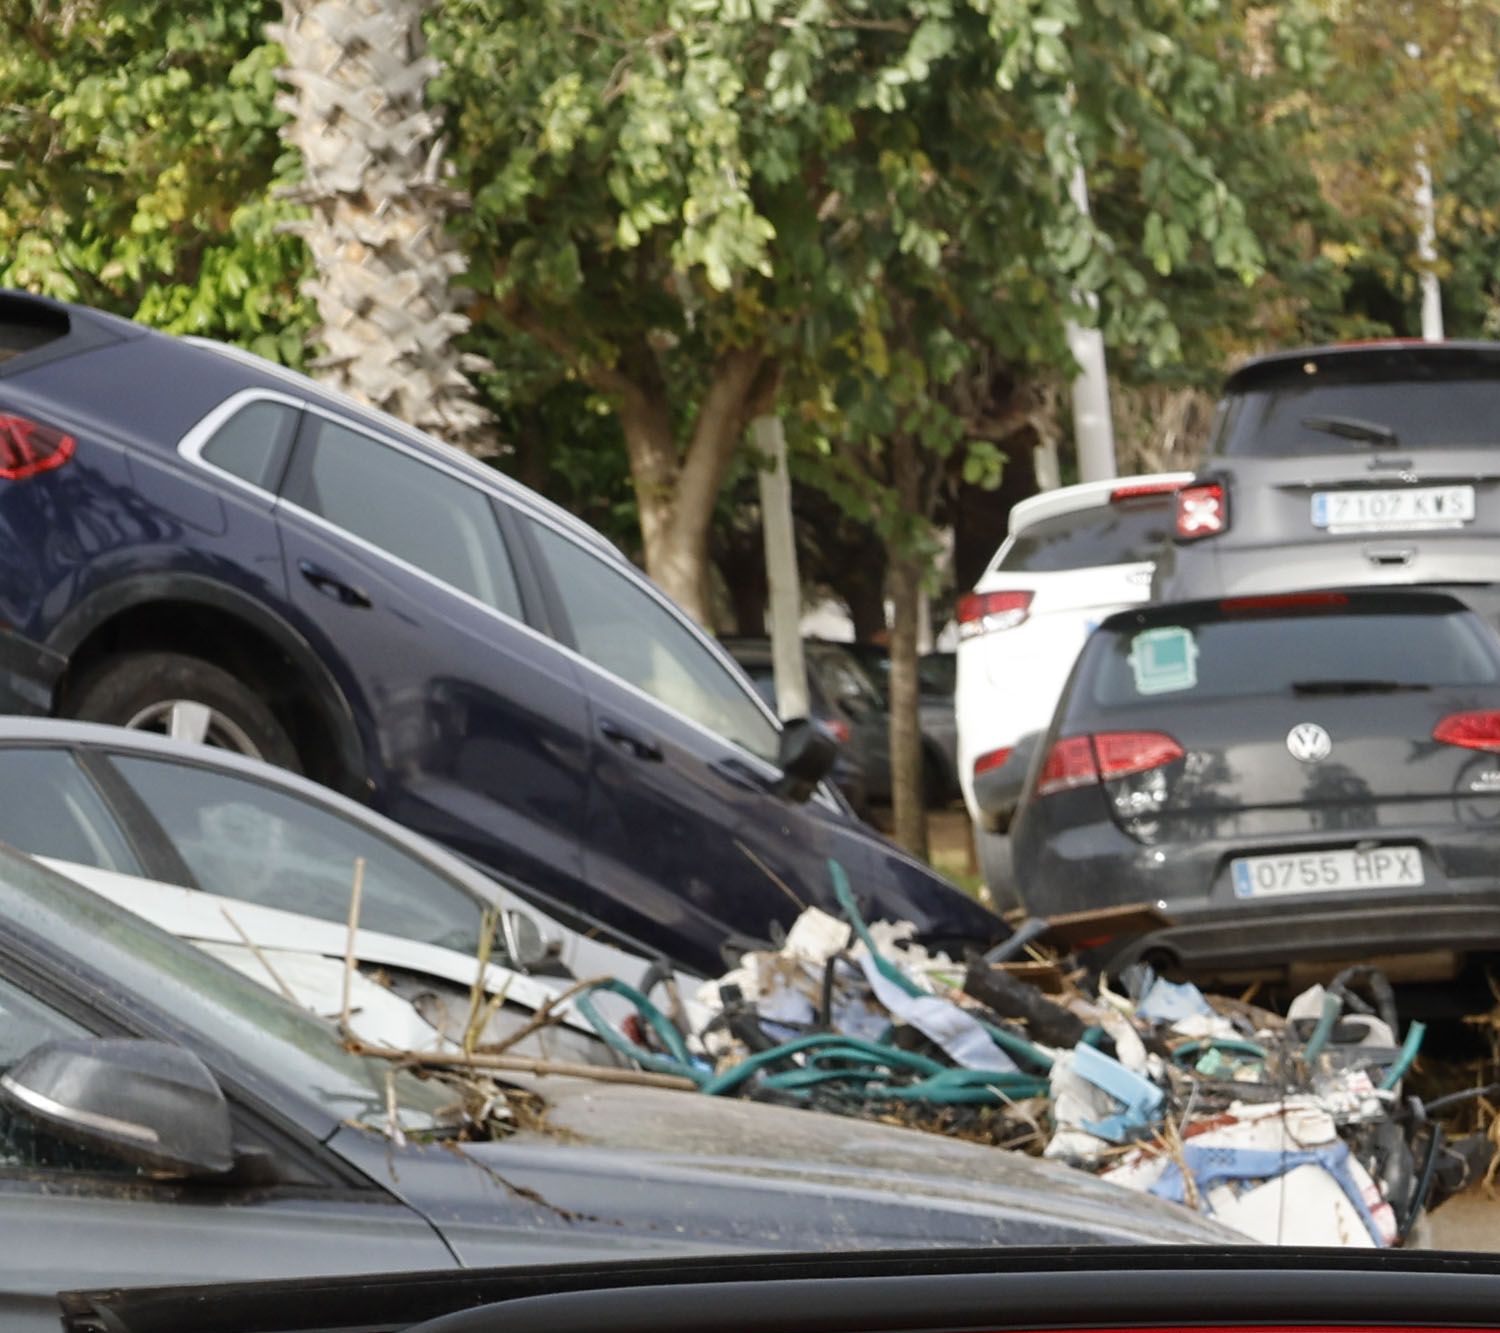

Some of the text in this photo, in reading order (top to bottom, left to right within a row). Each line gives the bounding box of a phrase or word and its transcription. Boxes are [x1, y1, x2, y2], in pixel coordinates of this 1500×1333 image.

[1334, 494, 1401, 517] 7107
[1257, 852, 1415, 890] 0755 HPX
